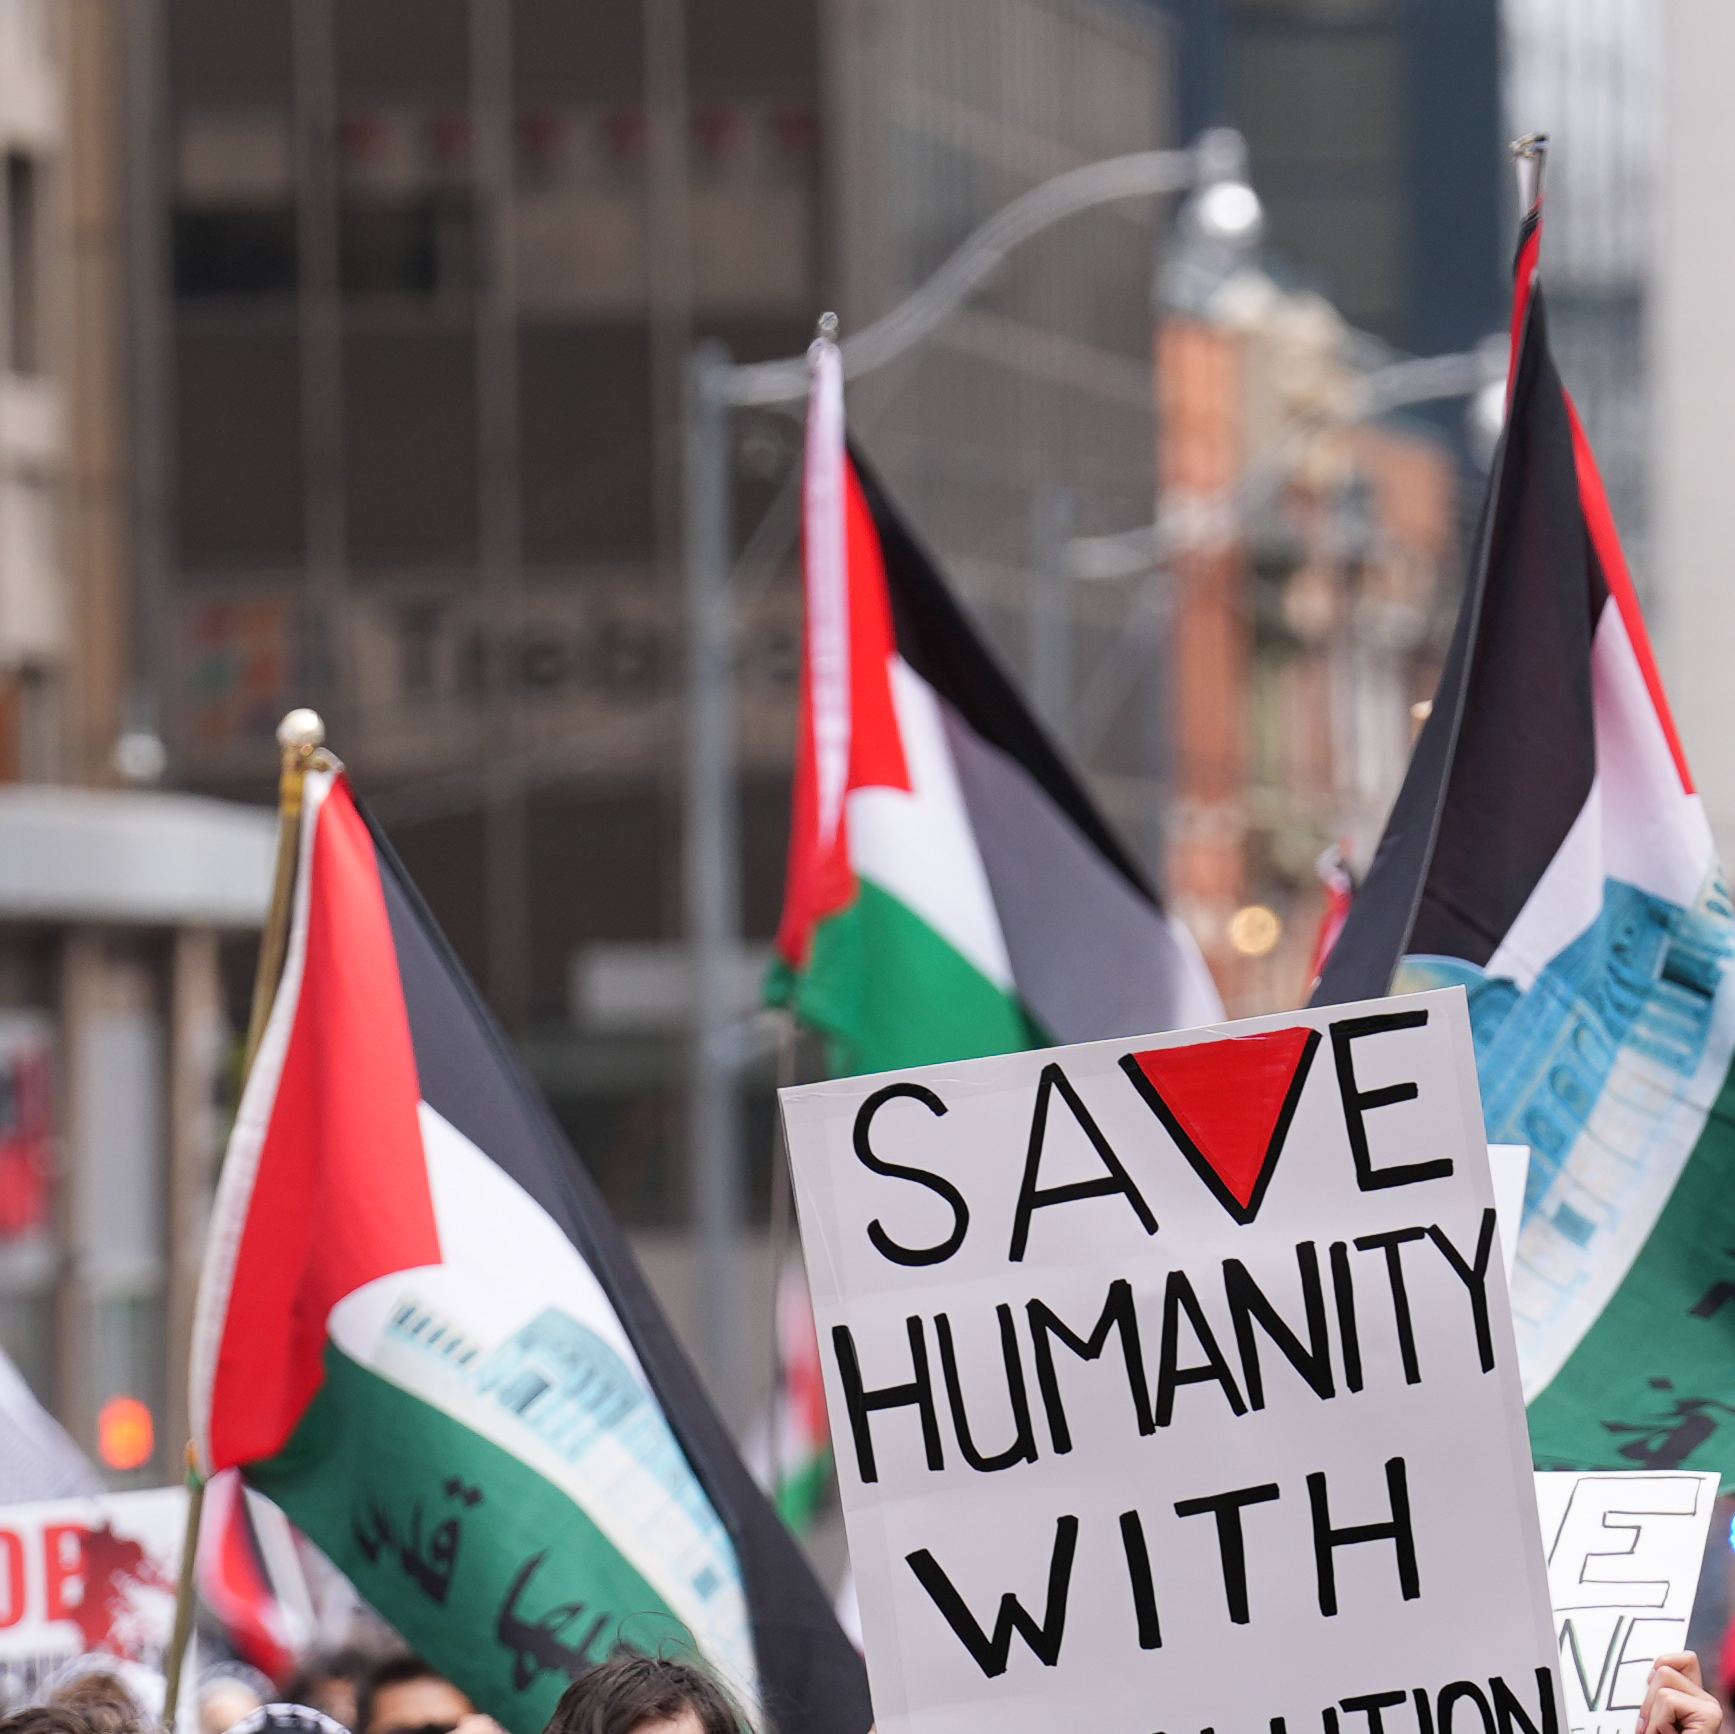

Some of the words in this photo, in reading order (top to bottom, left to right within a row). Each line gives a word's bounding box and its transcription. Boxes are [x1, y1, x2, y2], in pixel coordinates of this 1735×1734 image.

[852, 1009, 1455, 1267] SAVE
[832, 1207, 1498, 1484] HUMANITY
[905, 1456, 1422, 1679] WITH
